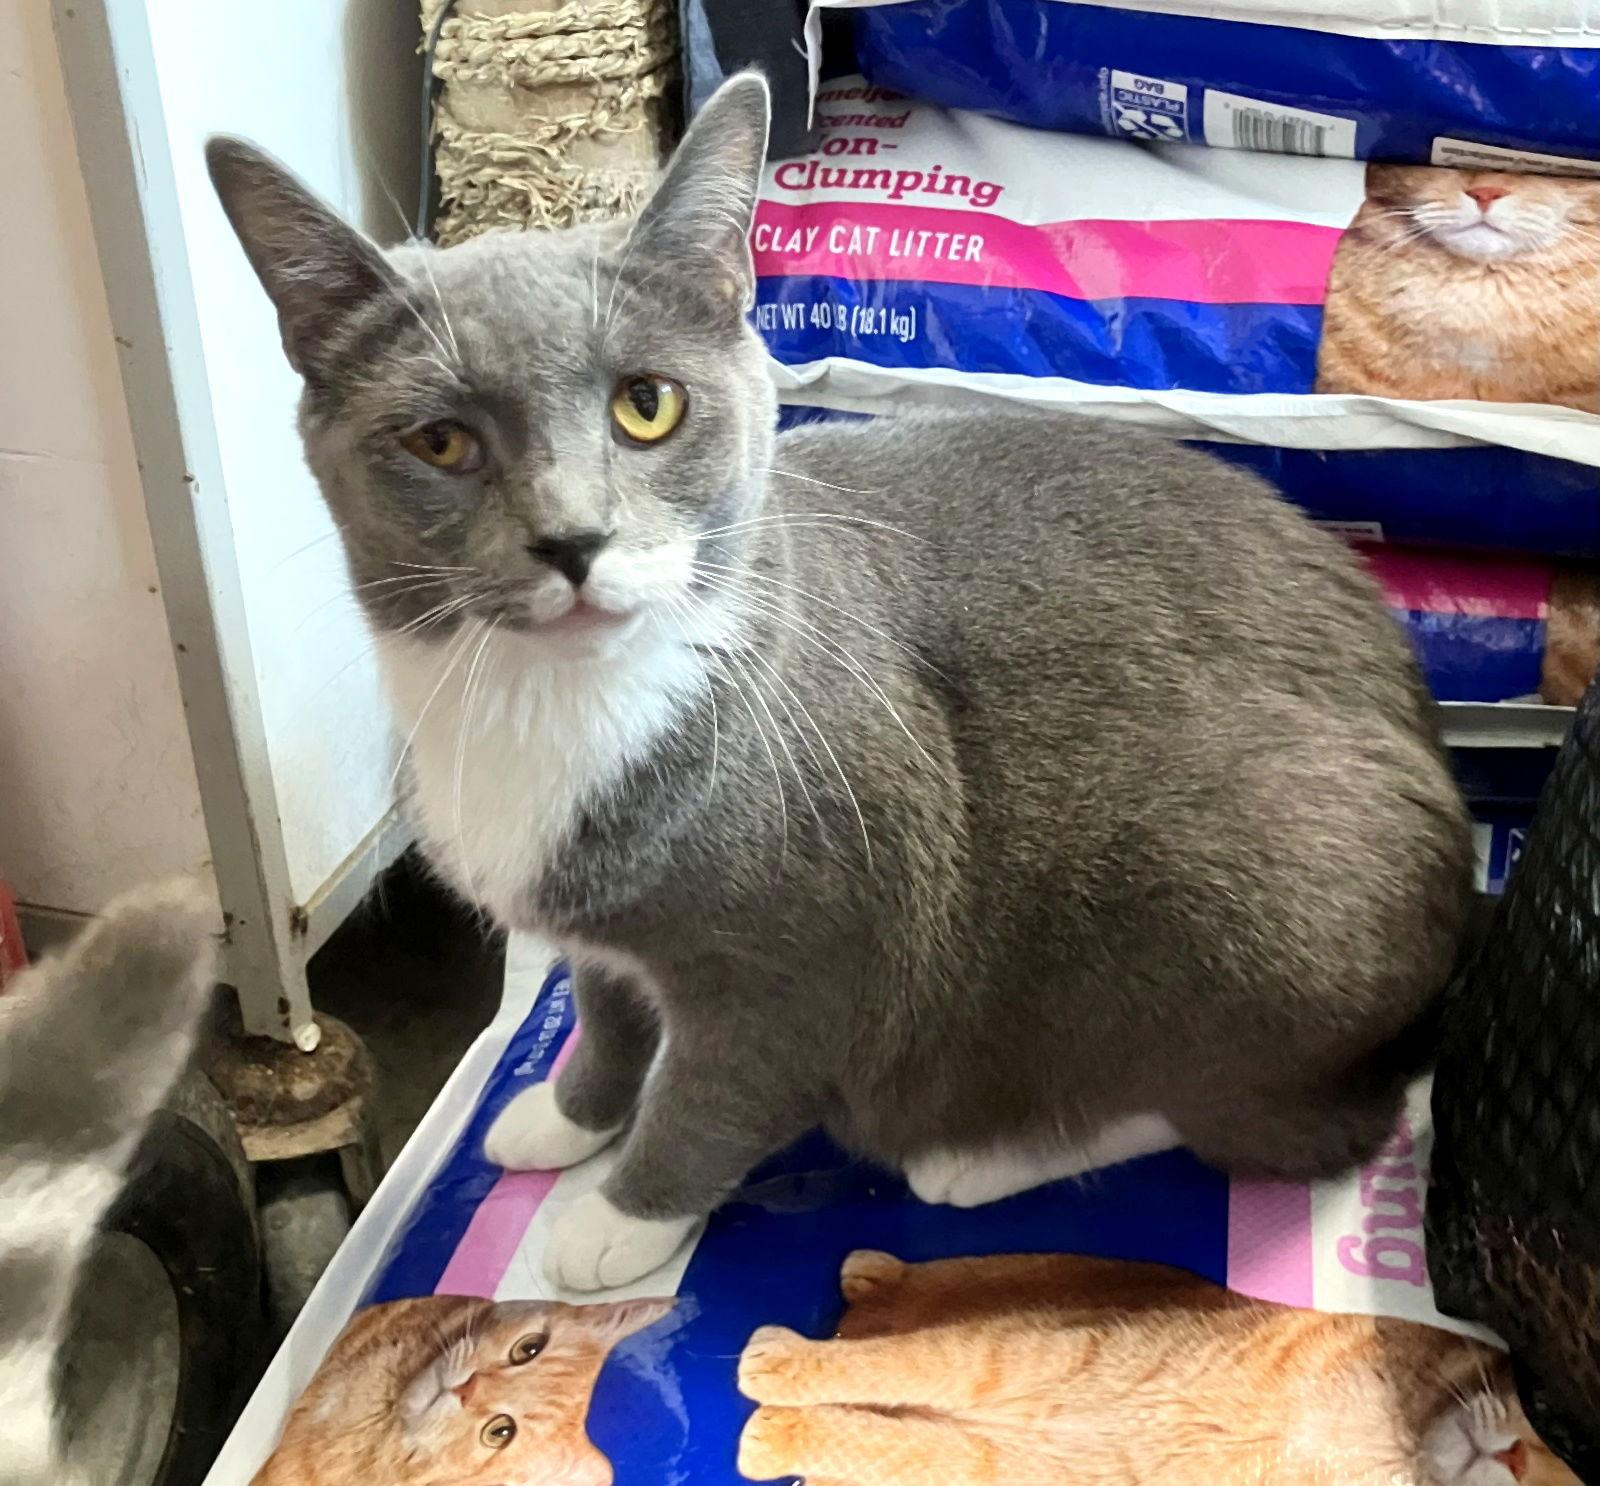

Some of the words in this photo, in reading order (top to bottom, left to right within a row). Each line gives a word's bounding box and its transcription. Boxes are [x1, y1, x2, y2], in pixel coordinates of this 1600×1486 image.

[1133, 79, 1165, 95] BAG
[1118, 90, 1180, 112] PLASTIC
[818, 110, 911, 129] cented
[820, 134, 898, 156] on-
[774, 161, 1005, 208] Clumping
[755, 223, 820, 253] CLAY
[829, 225, 881, 256] CAT
[889, 228, 985, 262] LITTER
[756, 303, 778, 331] NET
[781, 302, 806, 331] WT
[810, 301, 832, 330] 40
[850, 304, 887, 338] (18.1
[890, 305, 916, 343] kg)
